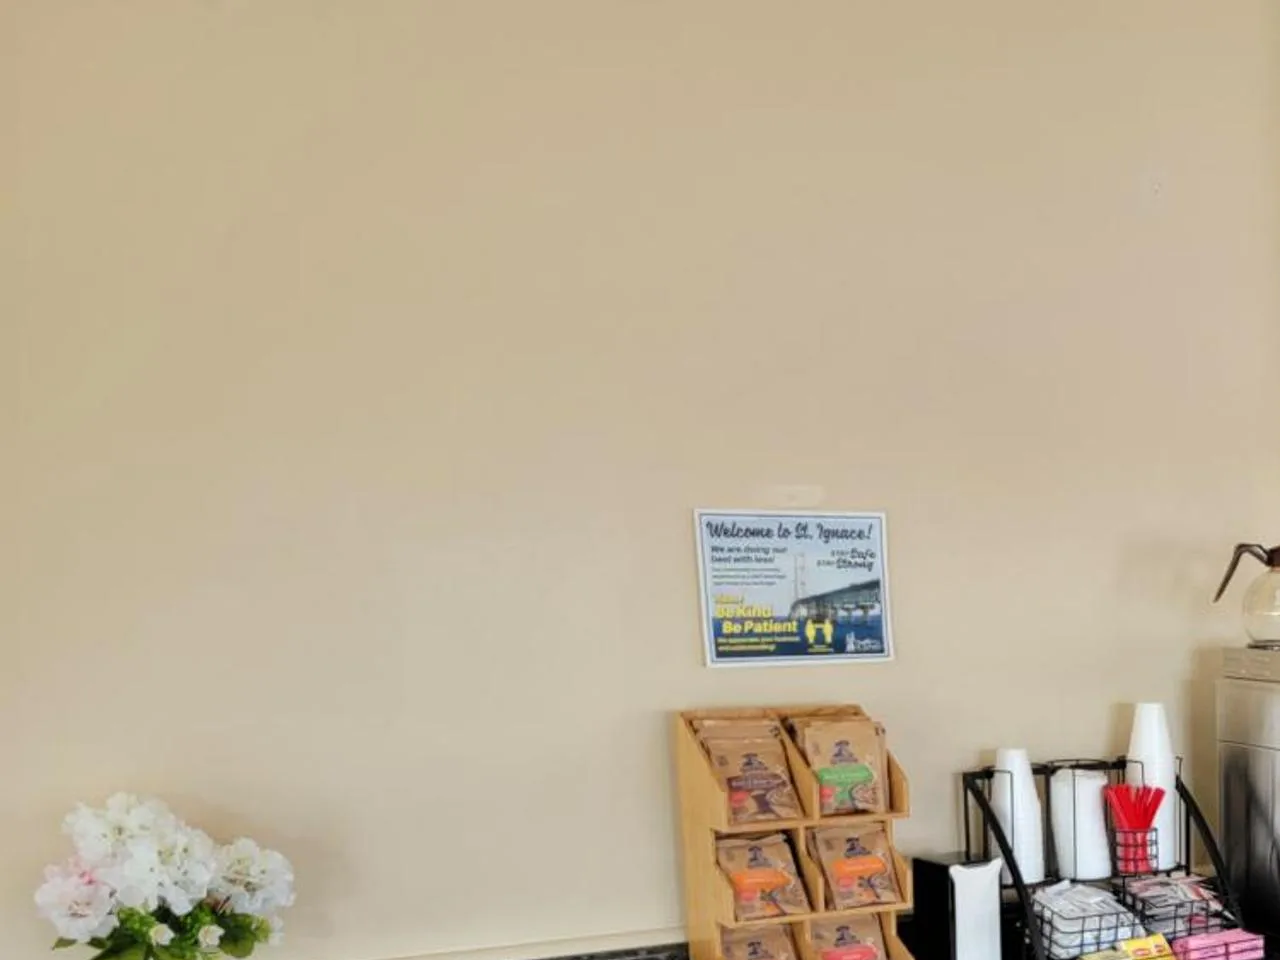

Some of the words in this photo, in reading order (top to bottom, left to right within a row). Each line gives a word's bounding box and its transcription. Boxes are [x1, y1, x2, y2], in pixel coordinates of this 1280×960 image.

[706, 521, 774, 538] Welcome
[777, 521, 791, 539] to
[795, 521, 813, 540] St.
[816, 522, 873, 544] Ignace!
[722, 620, 742, 634] Be
[743, 619, 799, 634] Patient
